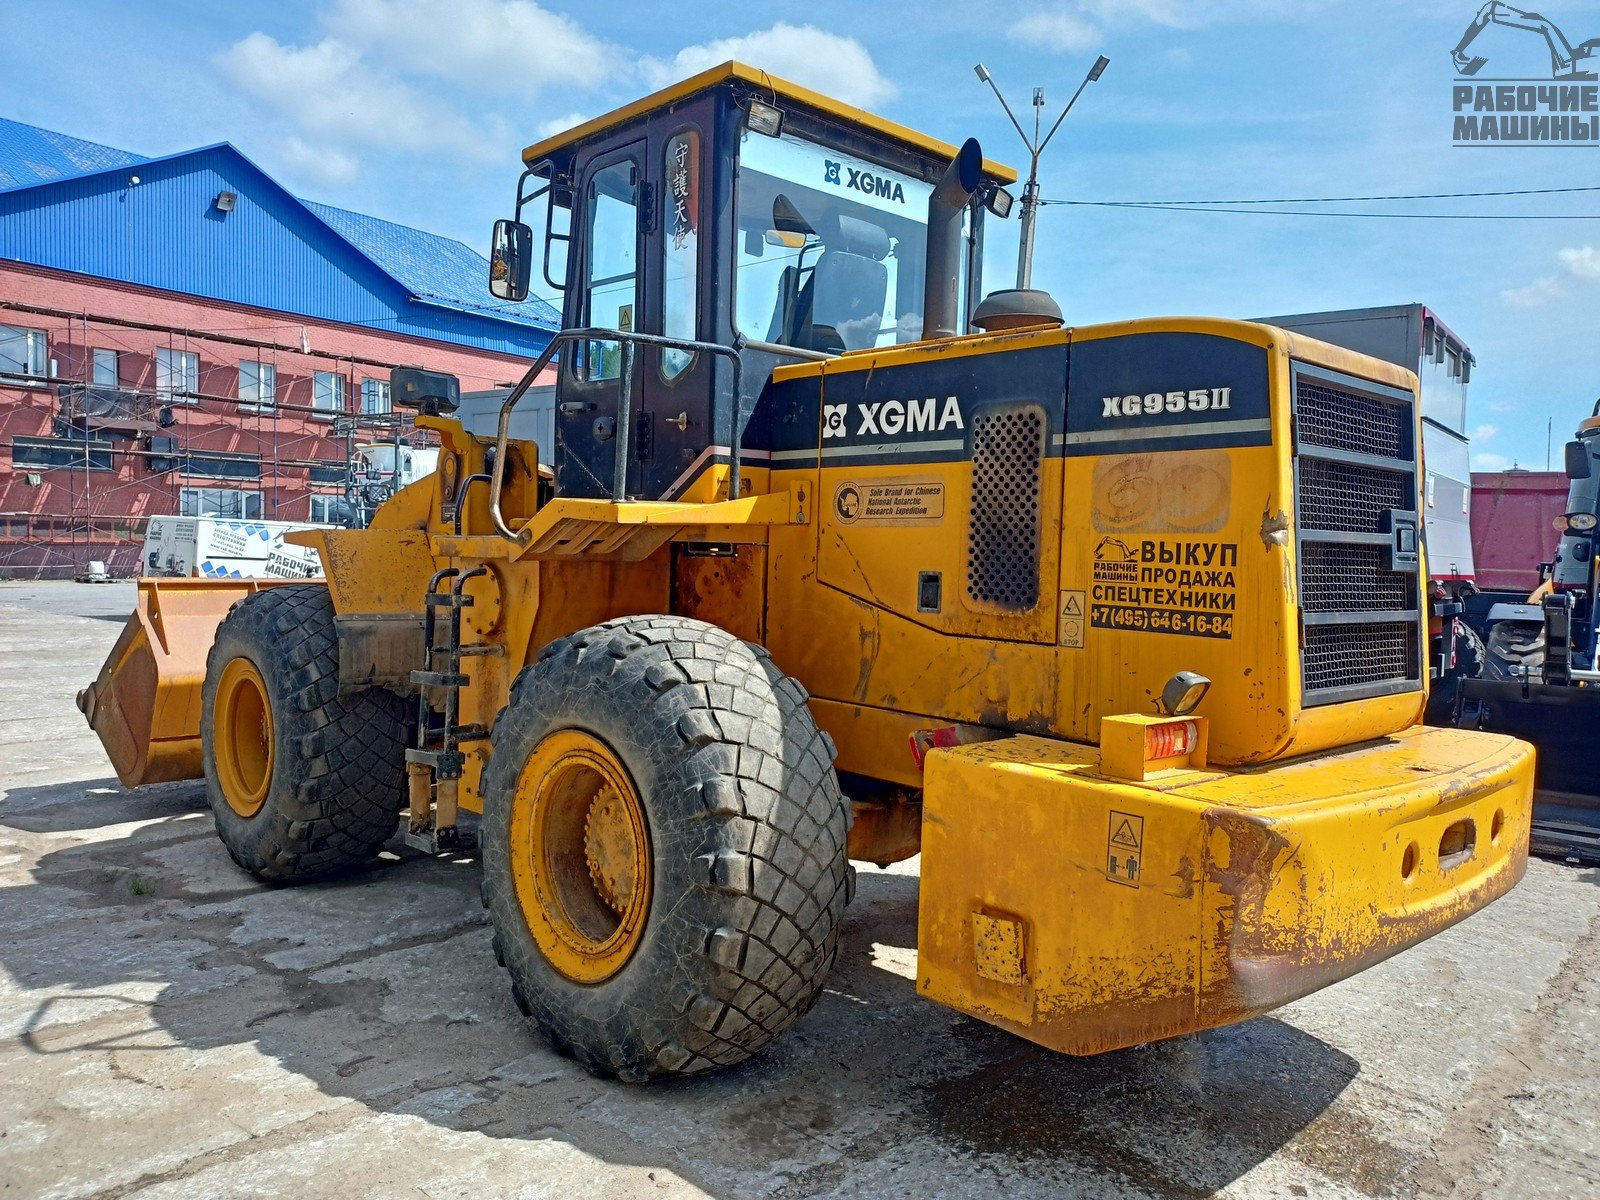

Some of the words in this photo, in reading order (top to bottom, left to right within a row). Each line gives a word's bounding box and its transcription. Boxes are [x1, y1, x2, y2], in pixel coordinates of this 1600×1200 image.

[673, 142, 689, 251] 守護天使
[846, 167, 905, 204] XGMA
[856, 396, 965, 435] XGMA
[868, 497, 893, 506] National
[894, 497, 922, 505] Antarctic
[870, 488, 883, 497] Sole
[884, 487, 902, 497] Brand
[904, 487, 914, 496] for
[915, 486, 941, 495] Chinese
[866, 506, 893, 515] Research
[895, 506, 928, 515] Expedition
[1141, 540, 1237, 567] ВЫКУП
[1093, 562, 1138, 572] РАБОЧИЕ
[1093, 572, 1138, 582] МАШИНЫ
[1141, 567, 1236, 589] ПРОДАЖА
[1092, 584, 1236, 611] СПЕЦТЕХНИКИ
